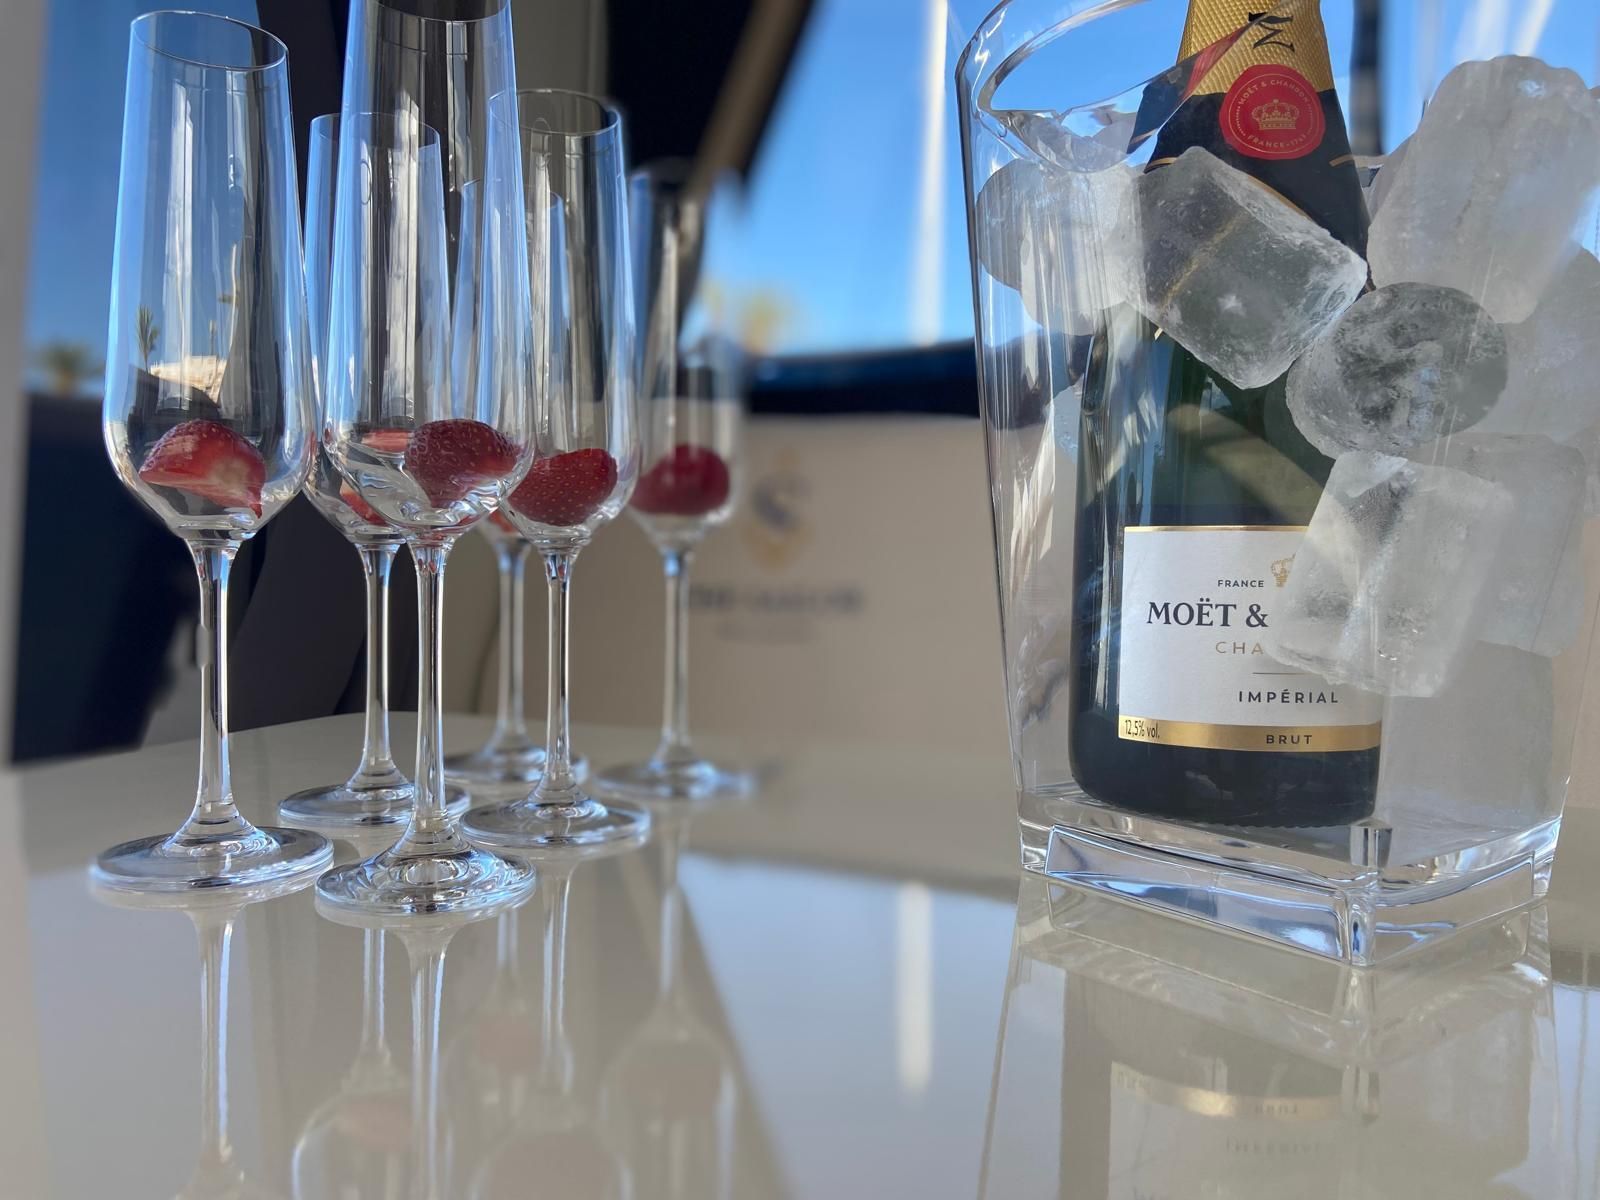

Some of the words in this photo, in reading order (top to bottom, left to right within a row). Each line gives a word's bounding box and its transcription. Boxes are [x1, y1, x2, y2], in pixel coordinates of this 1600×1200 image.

[1270, 79, 1309, 103] CHANDON
[1217, 579, 1265, 588] FRANCE
[1146, 597, 1237, 627] MOËT
[1245, 603, 1269, 628] &
[1215, 641, 1264, 655] CHA
[1238, 688, 1338, 704] IMPÉRIAL
[1124, 719, 1145, 737] 12,5%
[1146, 722, 1160, 740] vol.
[1266, 734, 1313, 745] BRUT
